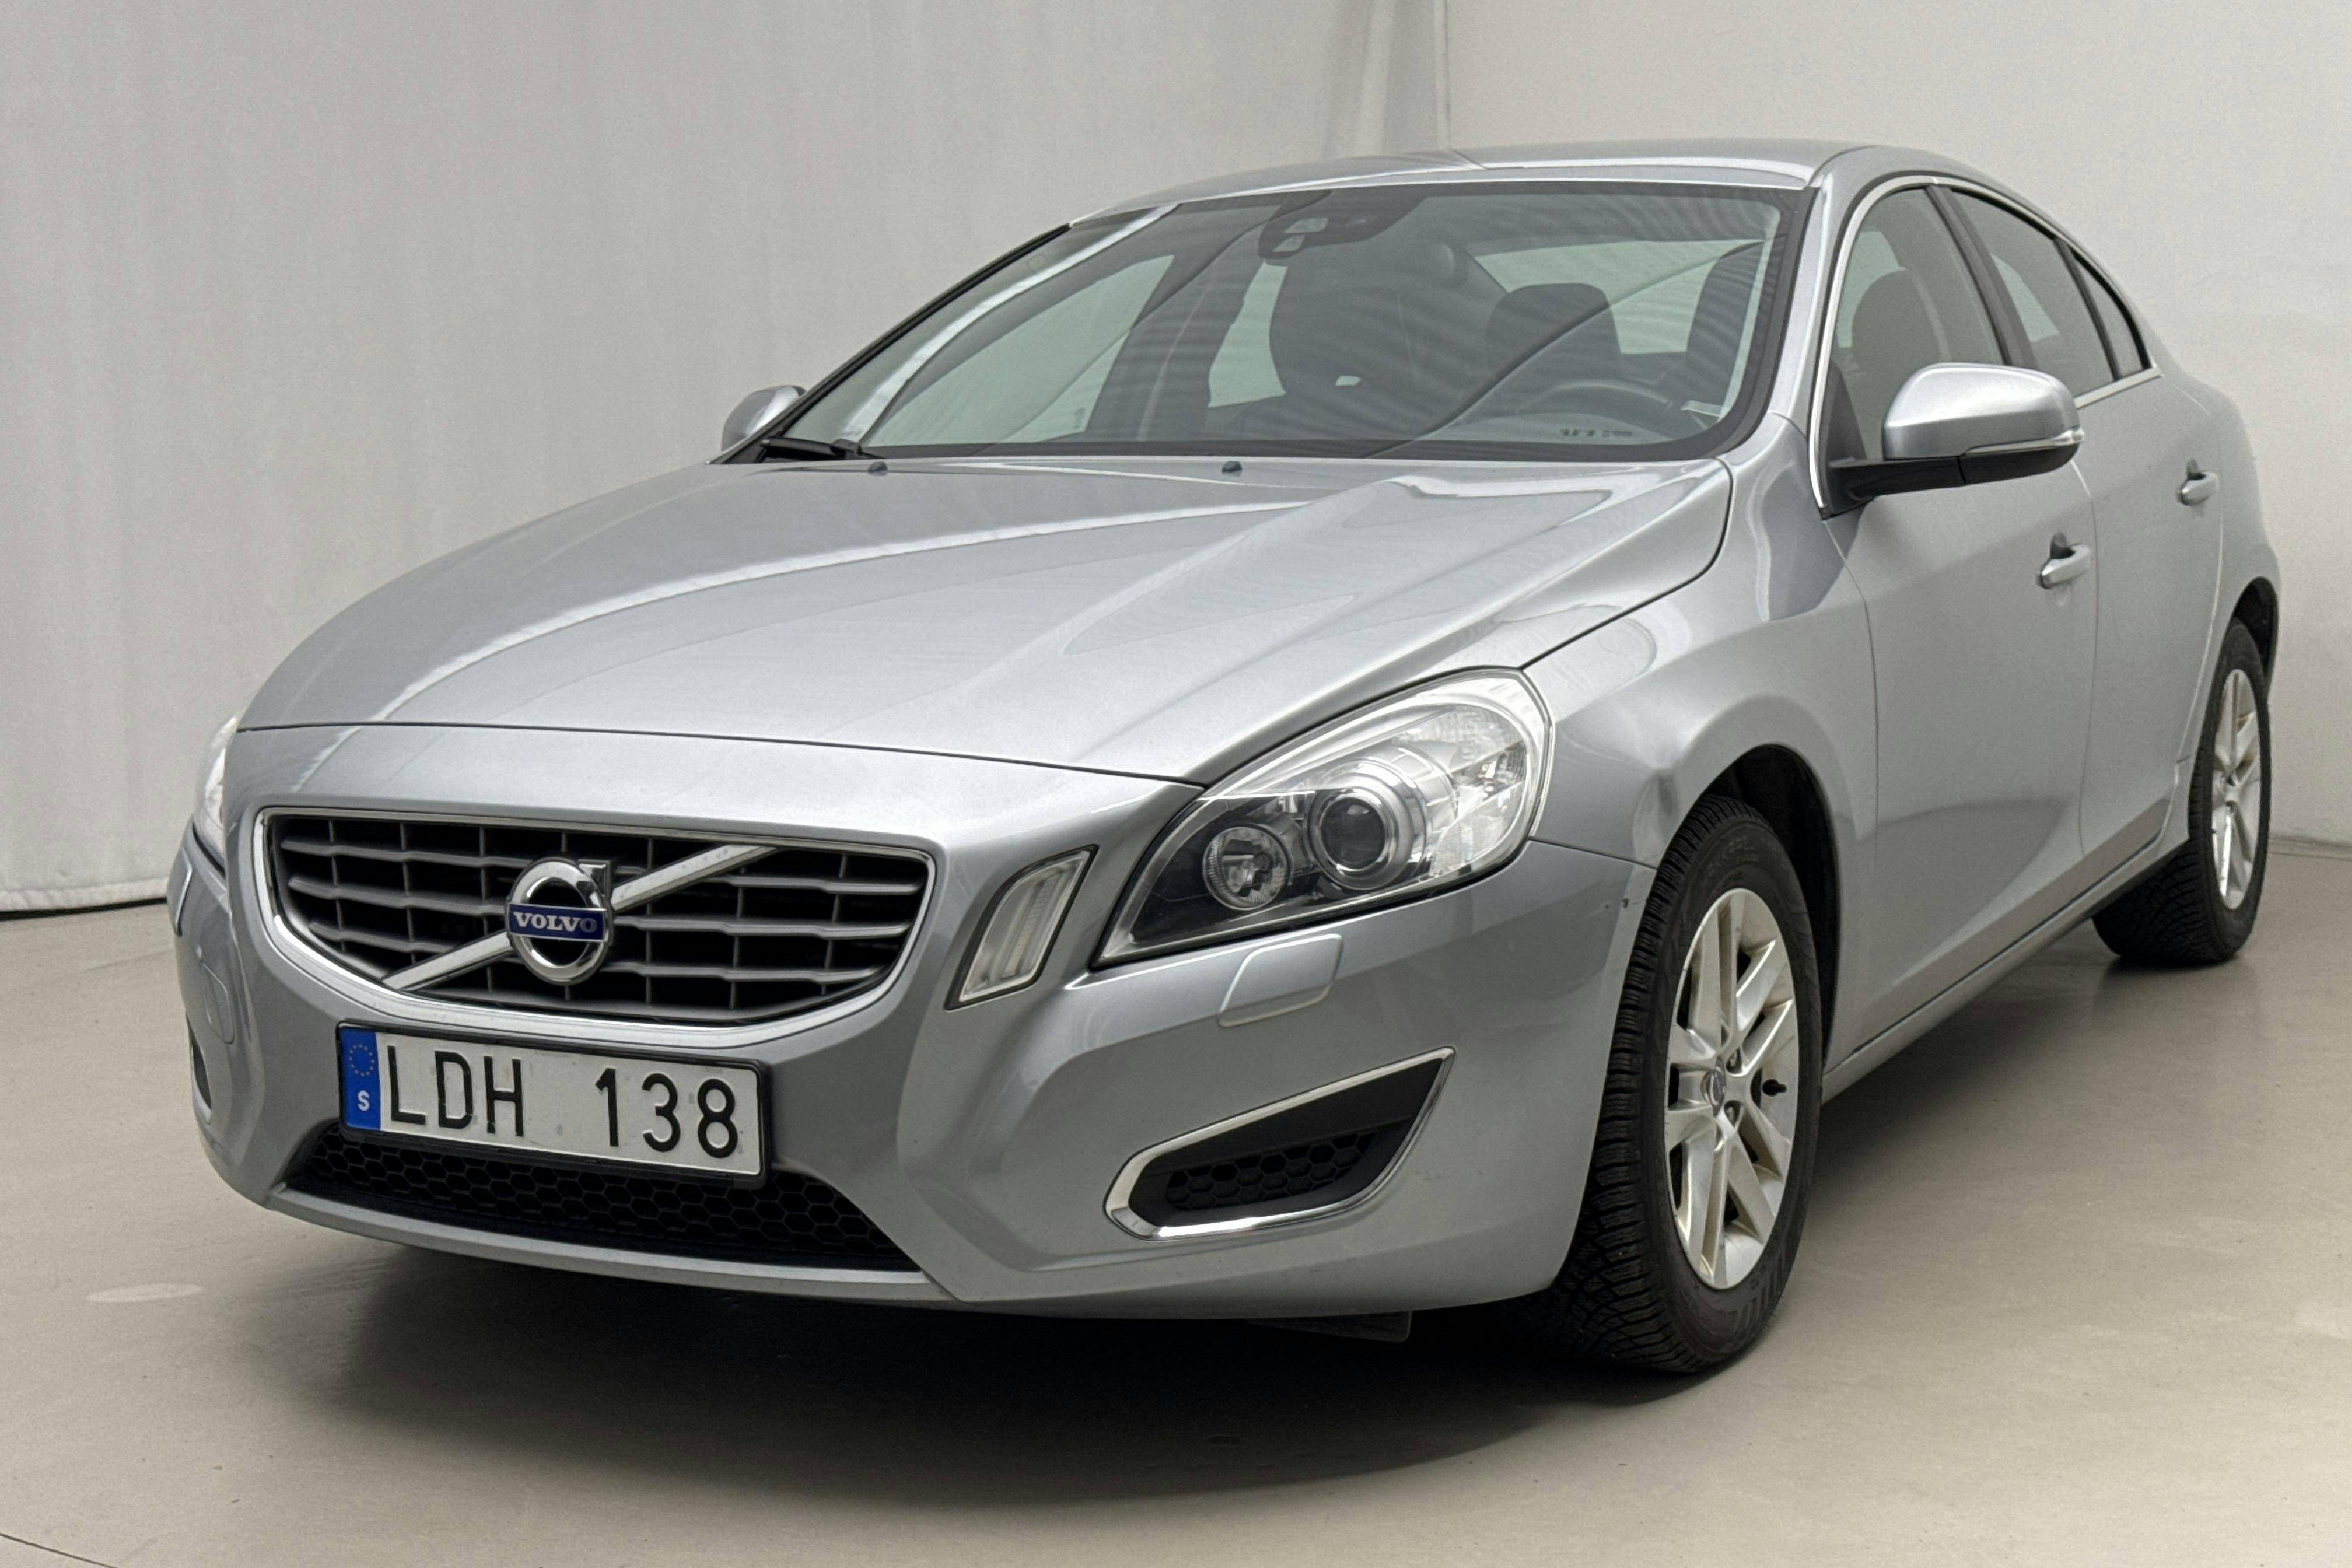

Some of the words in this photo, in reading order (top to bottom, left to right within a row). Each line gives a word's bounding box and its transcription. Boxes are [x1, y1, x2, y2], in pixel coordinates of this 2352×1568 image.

[513, 912, 597, 933] VOLVO
[358, 1090, 370, 1111] S
[387, 1045, 524, 1138] LDH
[595, 1068, 738, 1159] 138
